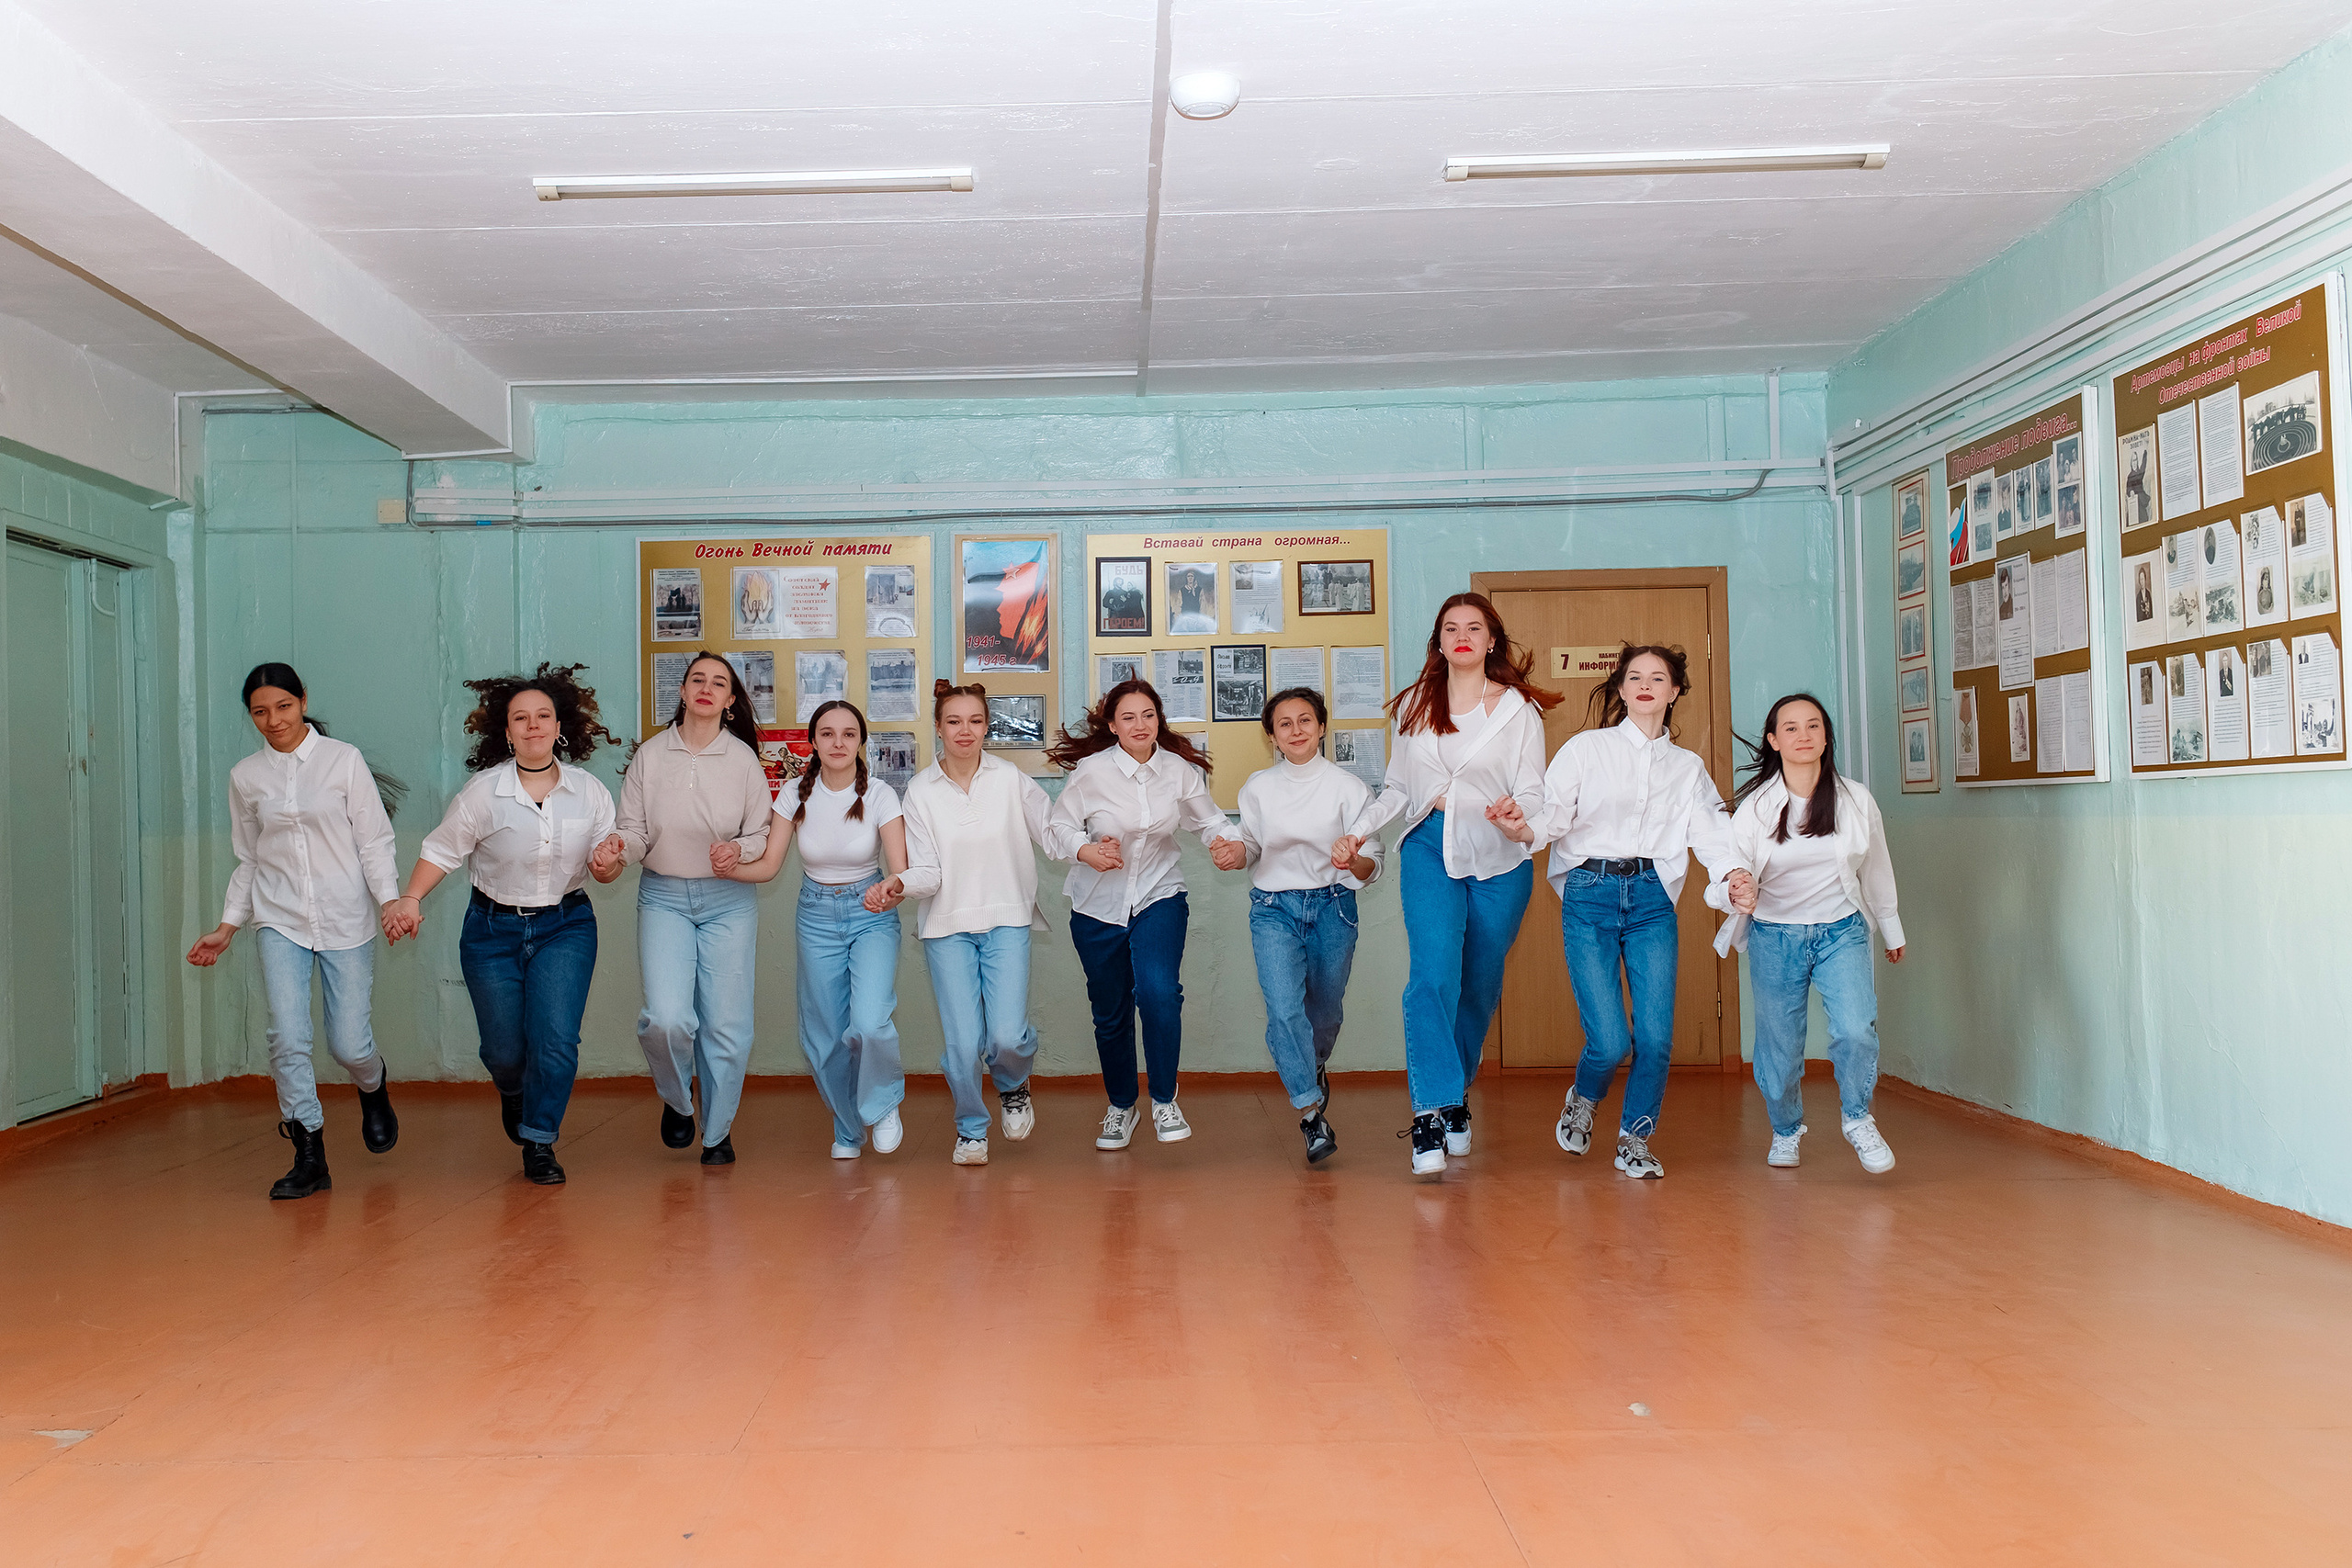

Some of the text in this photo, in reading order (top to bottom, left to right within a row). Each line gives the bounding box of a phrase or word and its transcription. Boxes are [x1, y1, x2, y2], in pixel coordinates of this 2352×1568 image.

[2131, 299, 2302, 394] Артемовцы на фронтах Великой
[2158, 345, 2271, 405] Отечественной войны
[1951, 434, 2019, 481] Продолжение
[695, 540, 893, 558] Огонь Вечной памяти
[1143, 536, 1351, 549] Вставай страна огромная...
[1114, 565, 1144, 576] БУДЬ
[1103, 617, 1146, 629] ГЕРОЕМ!
[966, 635, 1001, 649] 1941-
[977, 654, 1017, 666] 1945 г
[1560, 653, 1619, 671] 7 ИНФОРМ
